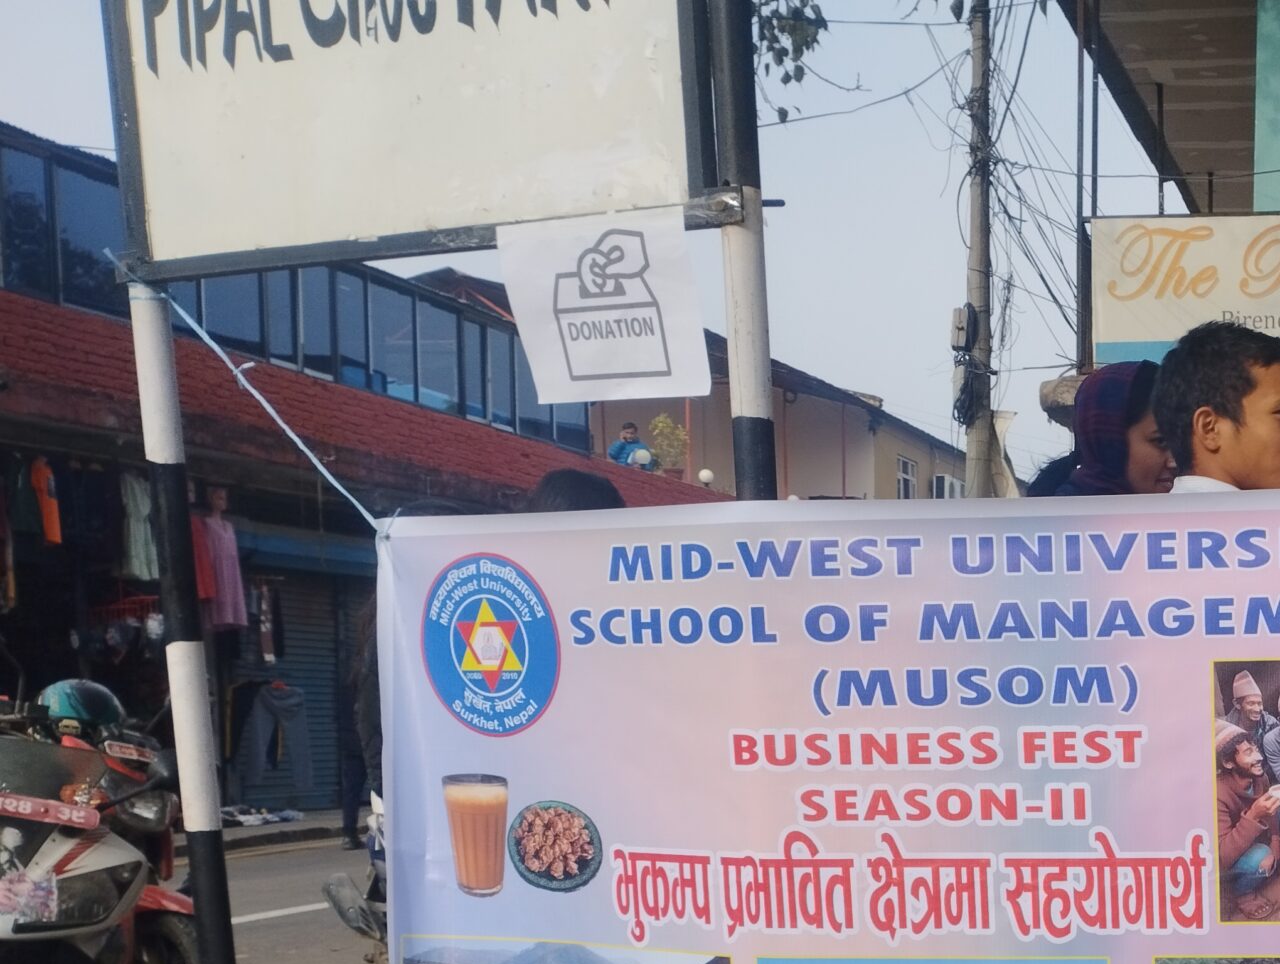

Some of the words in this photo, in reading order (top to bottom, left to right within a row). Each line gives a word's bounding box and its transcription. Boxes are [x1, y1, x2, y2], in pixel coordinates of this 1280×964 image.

[1107, 223, 1220, 301] The
[567, 316, 655, 341] DONATION
[609, 537, 921, 582] MID-WEST
[439, 579, 478, 626] Mid-West
[480, 577, 532, 622] University
[570, 607, 777, 646] SCHOOL
[804, 605, 888, 643] OF
[494, 687, 526, 713] नेपाल
[813, 664, 1138, 715] (MUSOM)
[452, 699, 503, 732] Surkhet,
[504, 699, 538, 728] Nepal
[733, 731, 997, 767] BUSINESS
[1022, 730, 1143, 764] FEST
[801, 787, 1087, 822] SEASON-II
[613, 848, 711, 942] भुकम्प
[720, 830, 854, 938] प्रभावित
[866, 832, 991, 941] क्षेत्रमा
[1004, 832, 1206, 938] सहयोगार्थ
